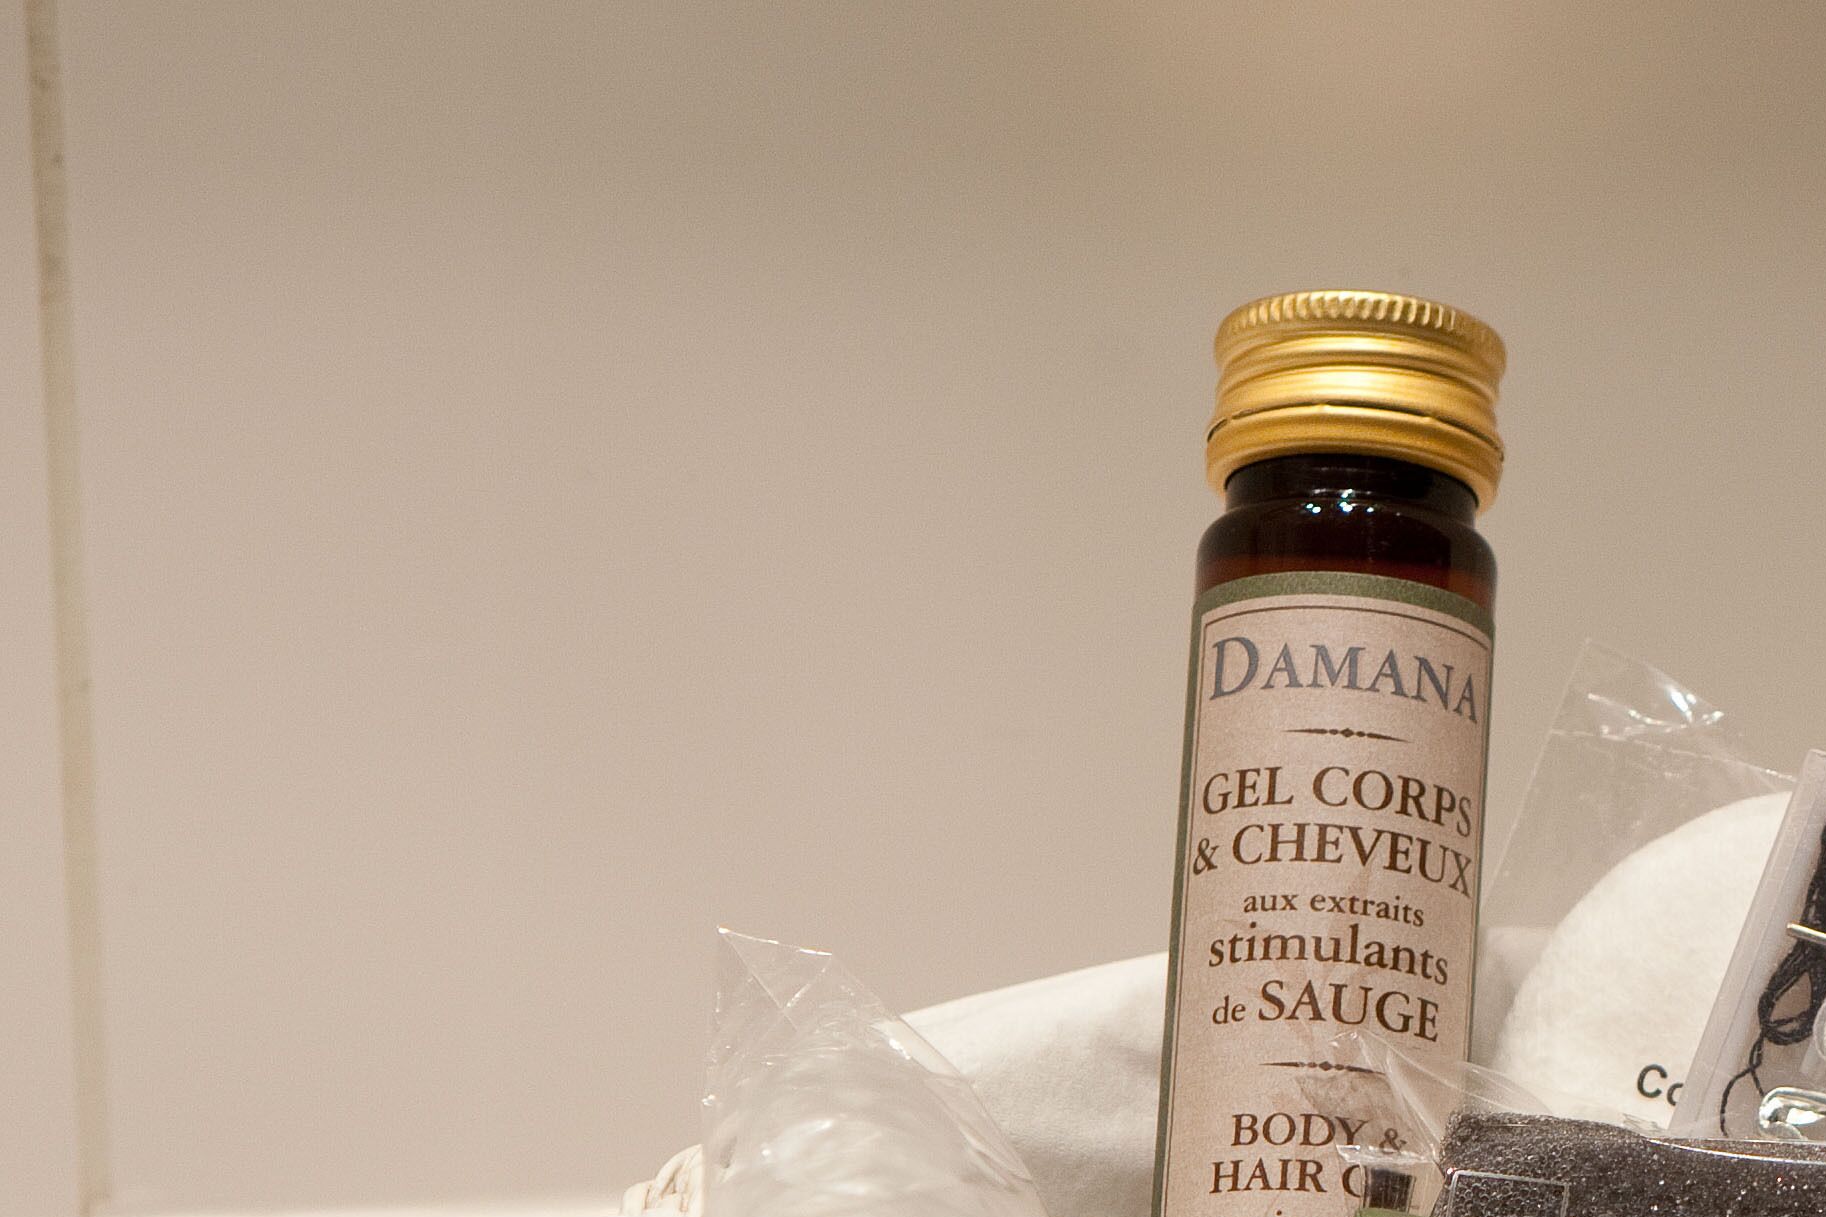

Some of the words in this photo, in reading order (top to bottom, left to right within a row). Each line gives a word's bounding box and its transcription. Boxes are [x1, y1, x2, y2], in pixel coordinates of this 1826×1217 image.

[1209, 636, 1478, 724] DAMANA
[1203, 766, 1295, 815] GEL
[1312, 766, 1472, 838] CORPS
[1193, 837, 1218, 875] &
[1232, 823, 1472, 899] CHEVEUX
[1243, 893, 1298, 915] aux
[1310, 894, 1424, 928] extraits
[1208, 921, 1448, 985] stimulants
[1212, 995, 1247, 1024] de
[1258, 979, 1440, 1042] SAUGE
[1230, 1112, 1370, 1148] BODY
[1379, 1128, 1408, 1154] &
[1209, 1158, 1328, 1194] HAIR
